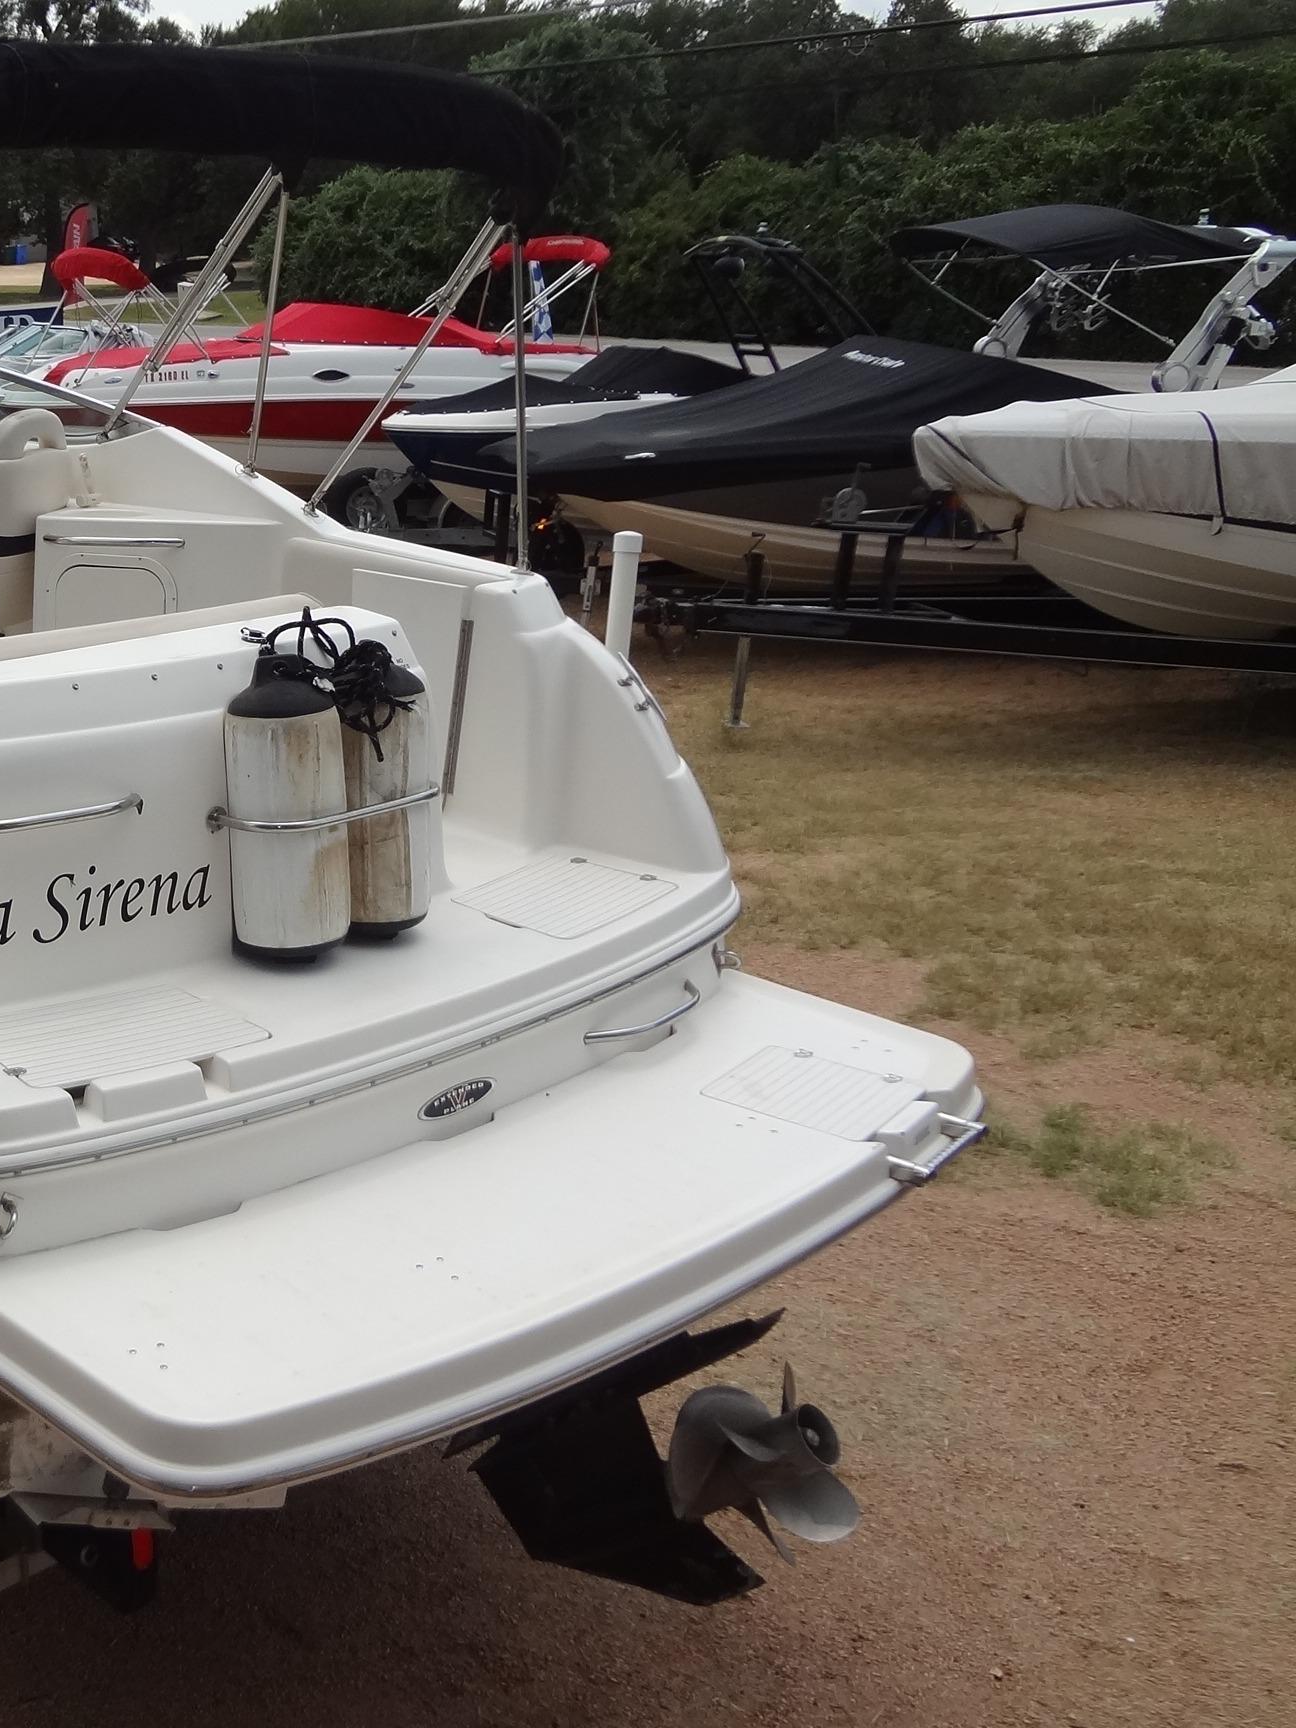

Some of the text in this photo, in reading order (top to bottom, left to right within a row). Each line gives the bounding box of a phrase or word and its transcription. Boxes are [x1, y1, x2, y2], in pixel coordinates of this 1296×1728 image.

[32, 864, 212, 944] Sirena
[434, 1082, 484, 1107] EXTENDED
[444, 1097, 475, 1114] PLANE
